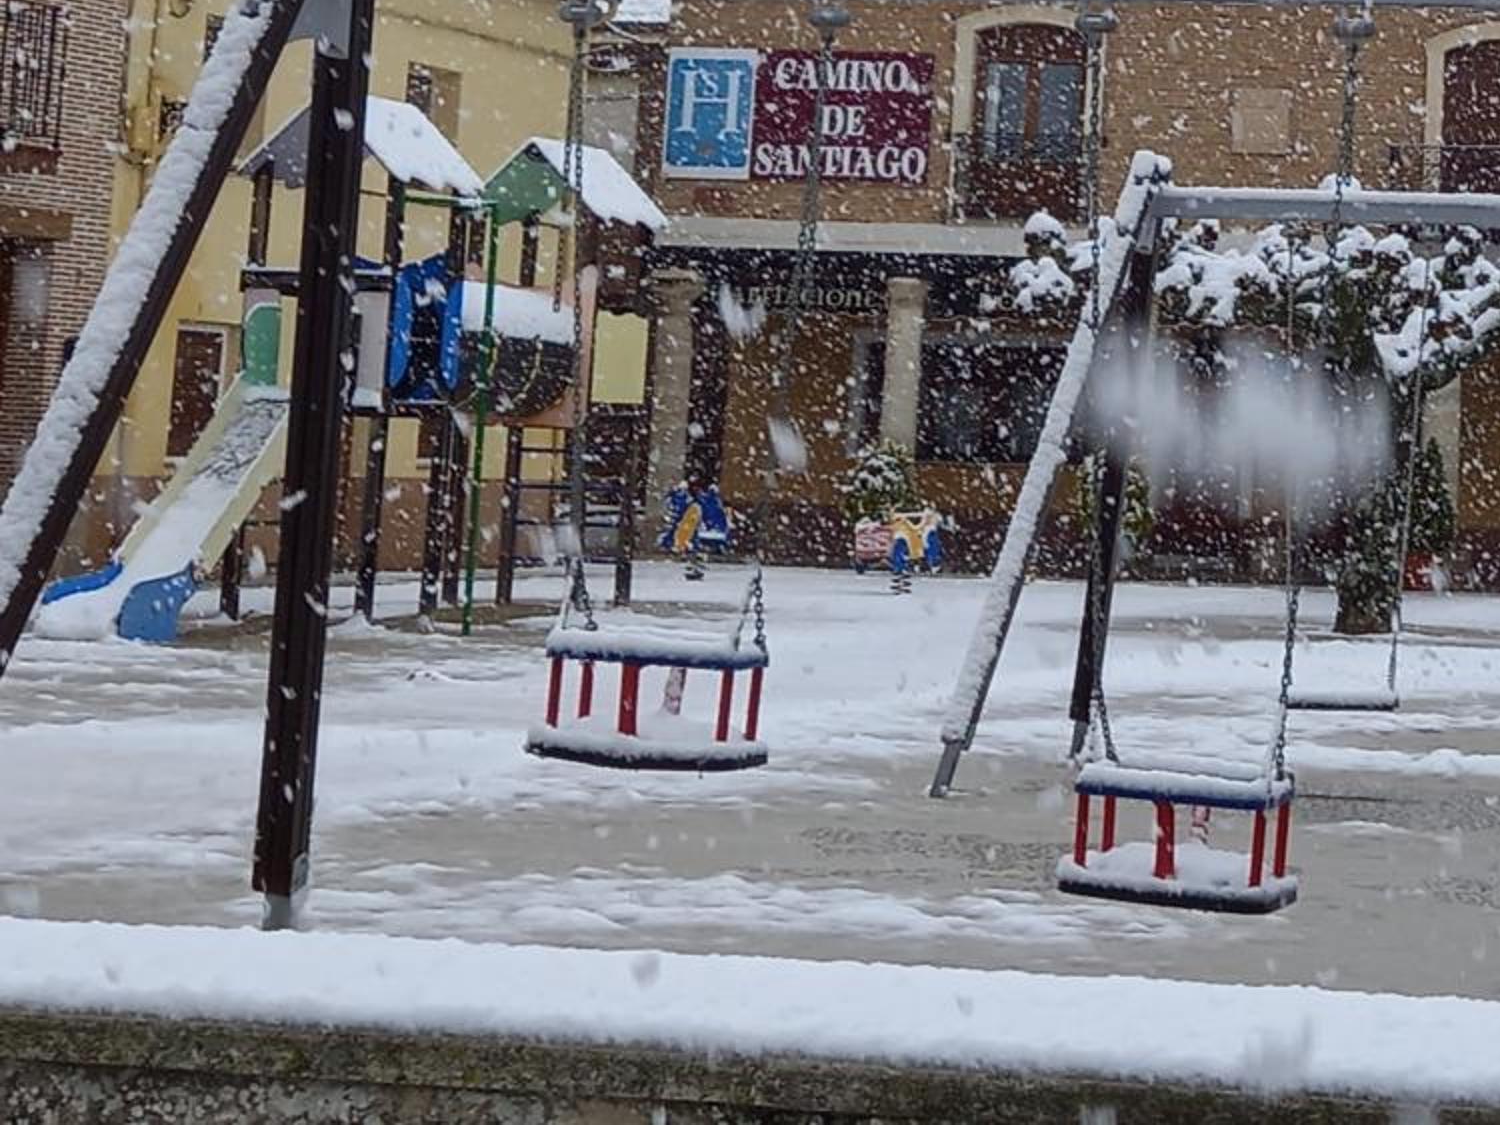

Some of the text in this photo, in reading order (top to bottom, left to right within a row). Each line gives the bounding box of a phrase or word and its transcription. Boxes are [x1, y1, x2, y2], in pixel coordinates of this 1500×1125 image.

[775, 57, 909, 92] CAMINO
[820, 104, 867, 138] DE
[754, 142, 927, 179] SANTIAGO
